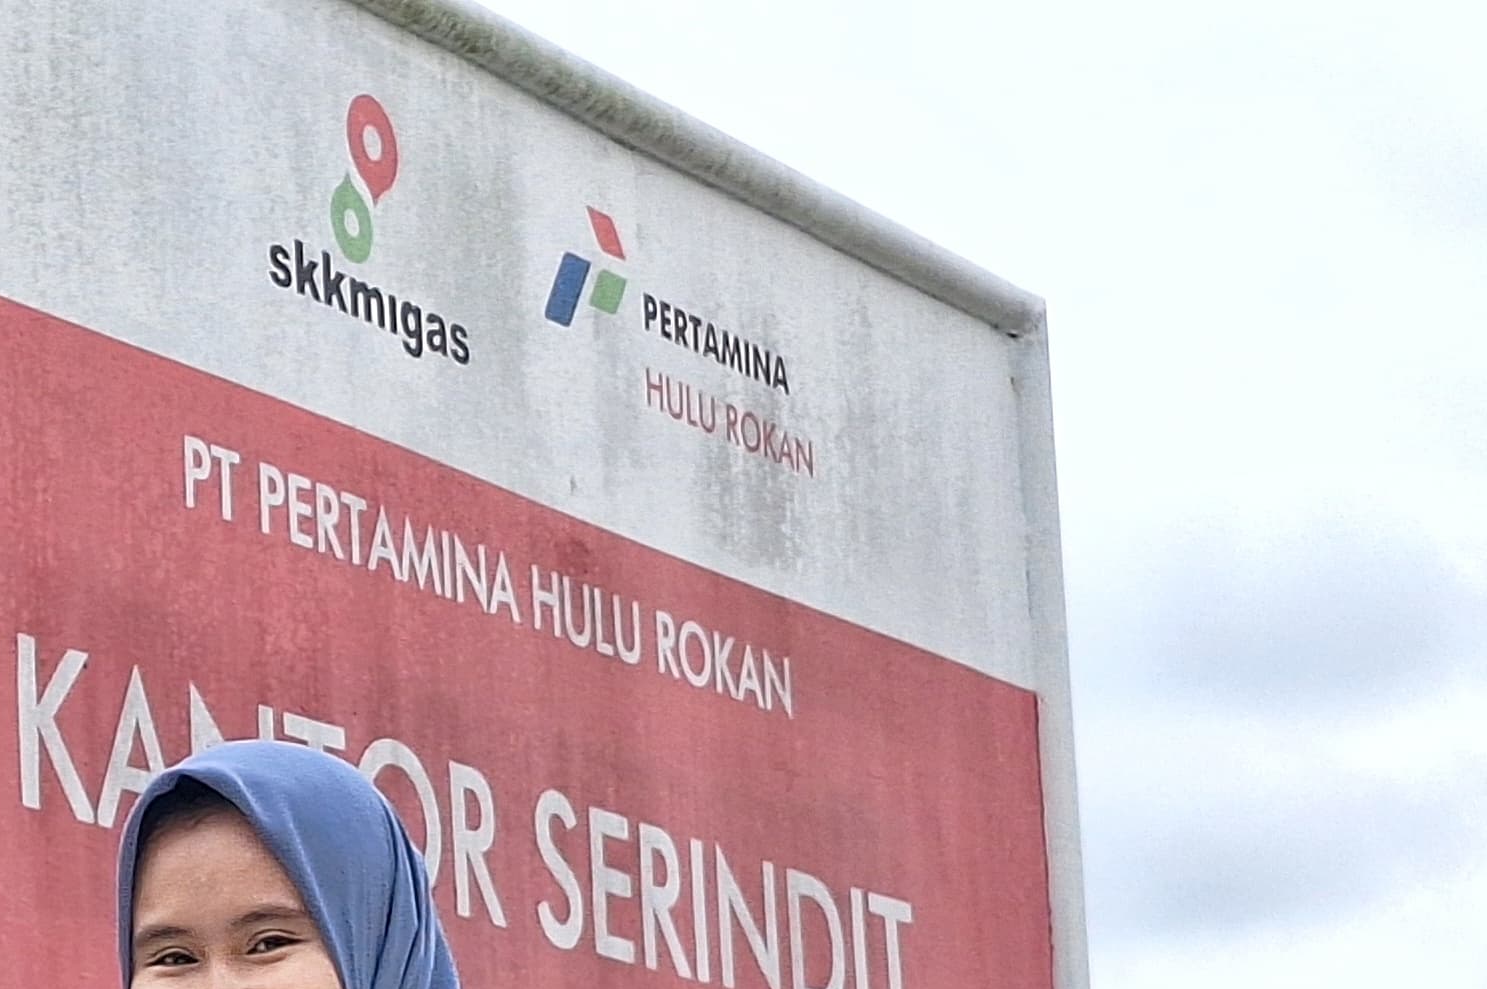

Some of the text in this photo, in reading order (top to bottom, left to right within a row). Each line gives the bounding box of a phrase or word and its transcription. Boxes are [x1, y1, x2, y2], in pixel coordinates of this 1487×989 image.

[269, 240, 470, 365] skkmigas
[643, 292, 790, 395] PERTAMINA
[645, 367, 814, 478] HULU ROKAN
[183, 434, 794, 719] PT PERTAMINA HULU ROKAN
